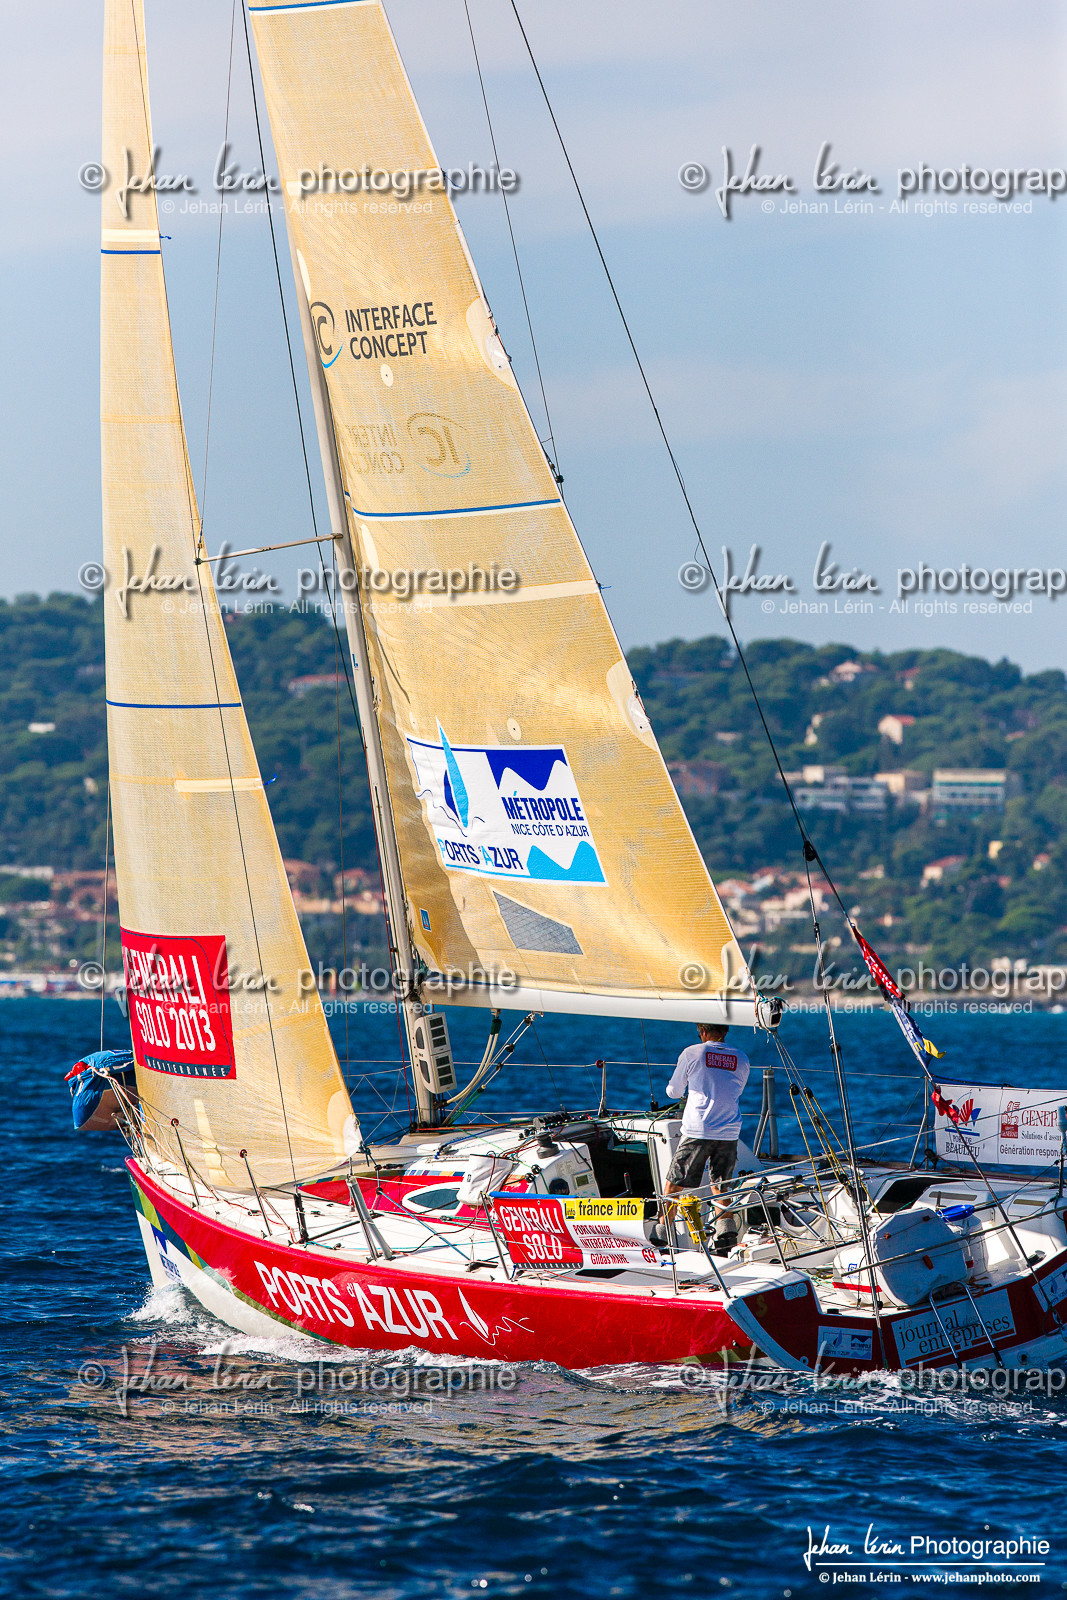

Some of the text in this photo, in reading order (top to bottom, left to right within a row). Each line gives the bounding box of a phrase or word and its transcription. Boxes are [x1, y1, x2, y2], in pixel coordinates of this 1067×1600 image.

[345, 302, 437, 332] INTERFACE
[350, 331, 428, 360] CONCEPT
[501, 791, 585, 821] MÉTROPOLE
[511, 822, 590, 837] NICE CÔTE D'AZUR
[437, 838, 481, 865] PORTS
[124, 946, 207, 1004] GENERALI
[135, 1000, 216, 1052] SOLO 2013
[707, 1053, 736, 1064] GENERALI
[999, 1144, 1034, 1156] Génération
[500, 1206, 564, 1234] GENERALI
[578, 1201, 638, 1216] france info
[522, 1233, 563, 1260] SOLO
[641, 1248, 657, 1263] 69
[254, 1260, 355, 1328] PORTS
